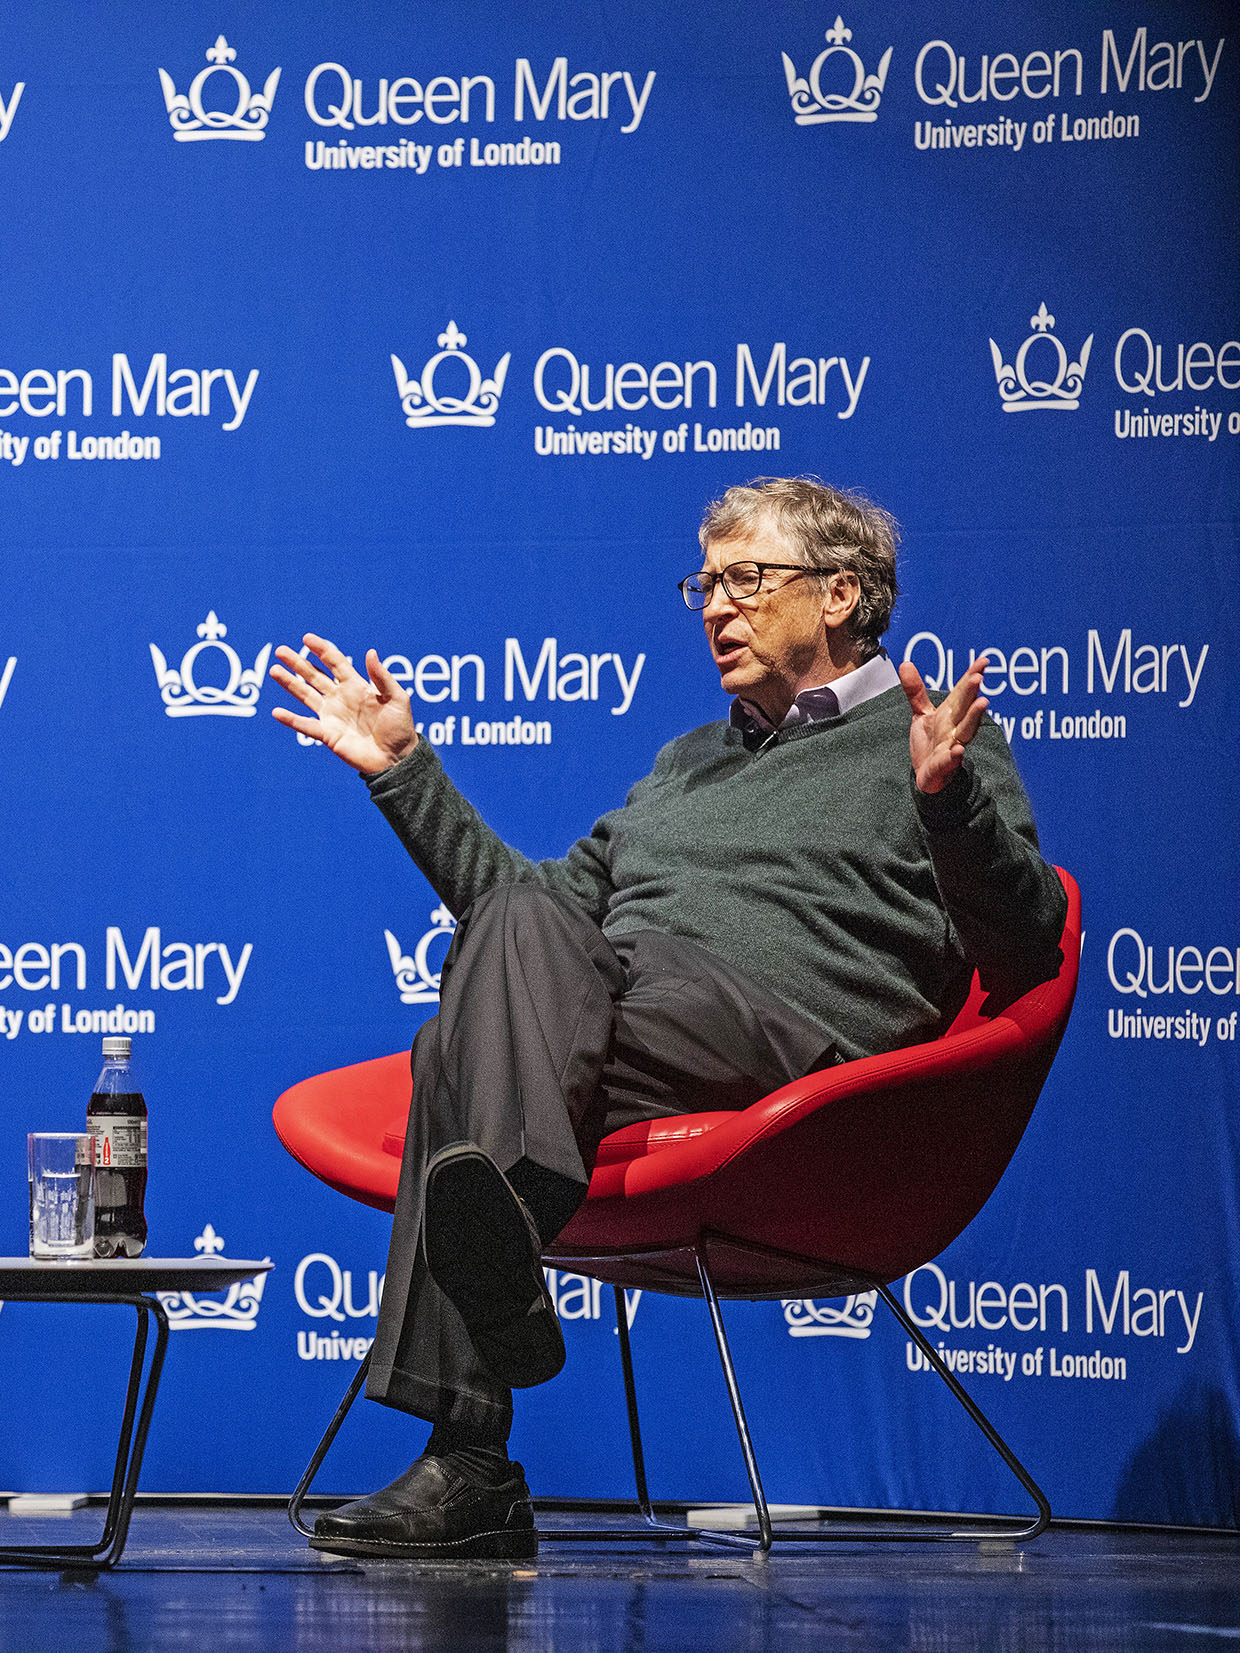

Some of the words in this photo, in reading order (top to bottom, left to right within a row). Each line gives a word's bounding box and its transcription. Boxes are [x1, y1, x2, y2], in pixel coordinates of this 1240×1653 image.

[915, 40, 1082, 107] Queen
[1101, 27, 1224, 102] Mary
[305, 62, 494, 130] Queen
[515, 57, 656, 133] Mary
[305, 139, 432, 174] University
[438, 138, 464, 167] of
[470, 137, 560, 166] London
[915, 116, 1027, 151] University
[1033, 114, 1055, 143] of
[1062, 111, 1139, 141] London
[534, 348, 716, 415] Queen
[736, 343, 870, 419] Mary
[1115, 328, 1240, 396] Quee
[112, 353, 259, 431] Mary
[34, 430, 62, 459] of
[67, 431, 160, 460] London
[535, 424, 657, 460] University
[663, 423, 688, 453] of
[694, 422, 780, 452] London
[1115, 406, 1222, 442] University
[505, 638, 646, 715] Mary
[1088, 629, 1209, 707] Mary
[429, 716, 455, 745] of
[461, 716, 551, 745] London
[1021, 709, 1043, 739] of
[1049, 710, 1126, 740] London
[106, 927, 253, 1005] Mary
[1108, 928, 1240, 998] Quee
[28, 1004, 56, 1033] of
[62, 1004, 155, 1034] London
[1108, 1008, 1211, 1047] University
[1217, 1011, 1238, 1041] of
[904, 1262, 1068, 1332] Queen
[1086, 1269, 1203, 1353] Mary
[1022, 1347, 1043, 1376] of
[1050, 1348, 1126, 1380] London
